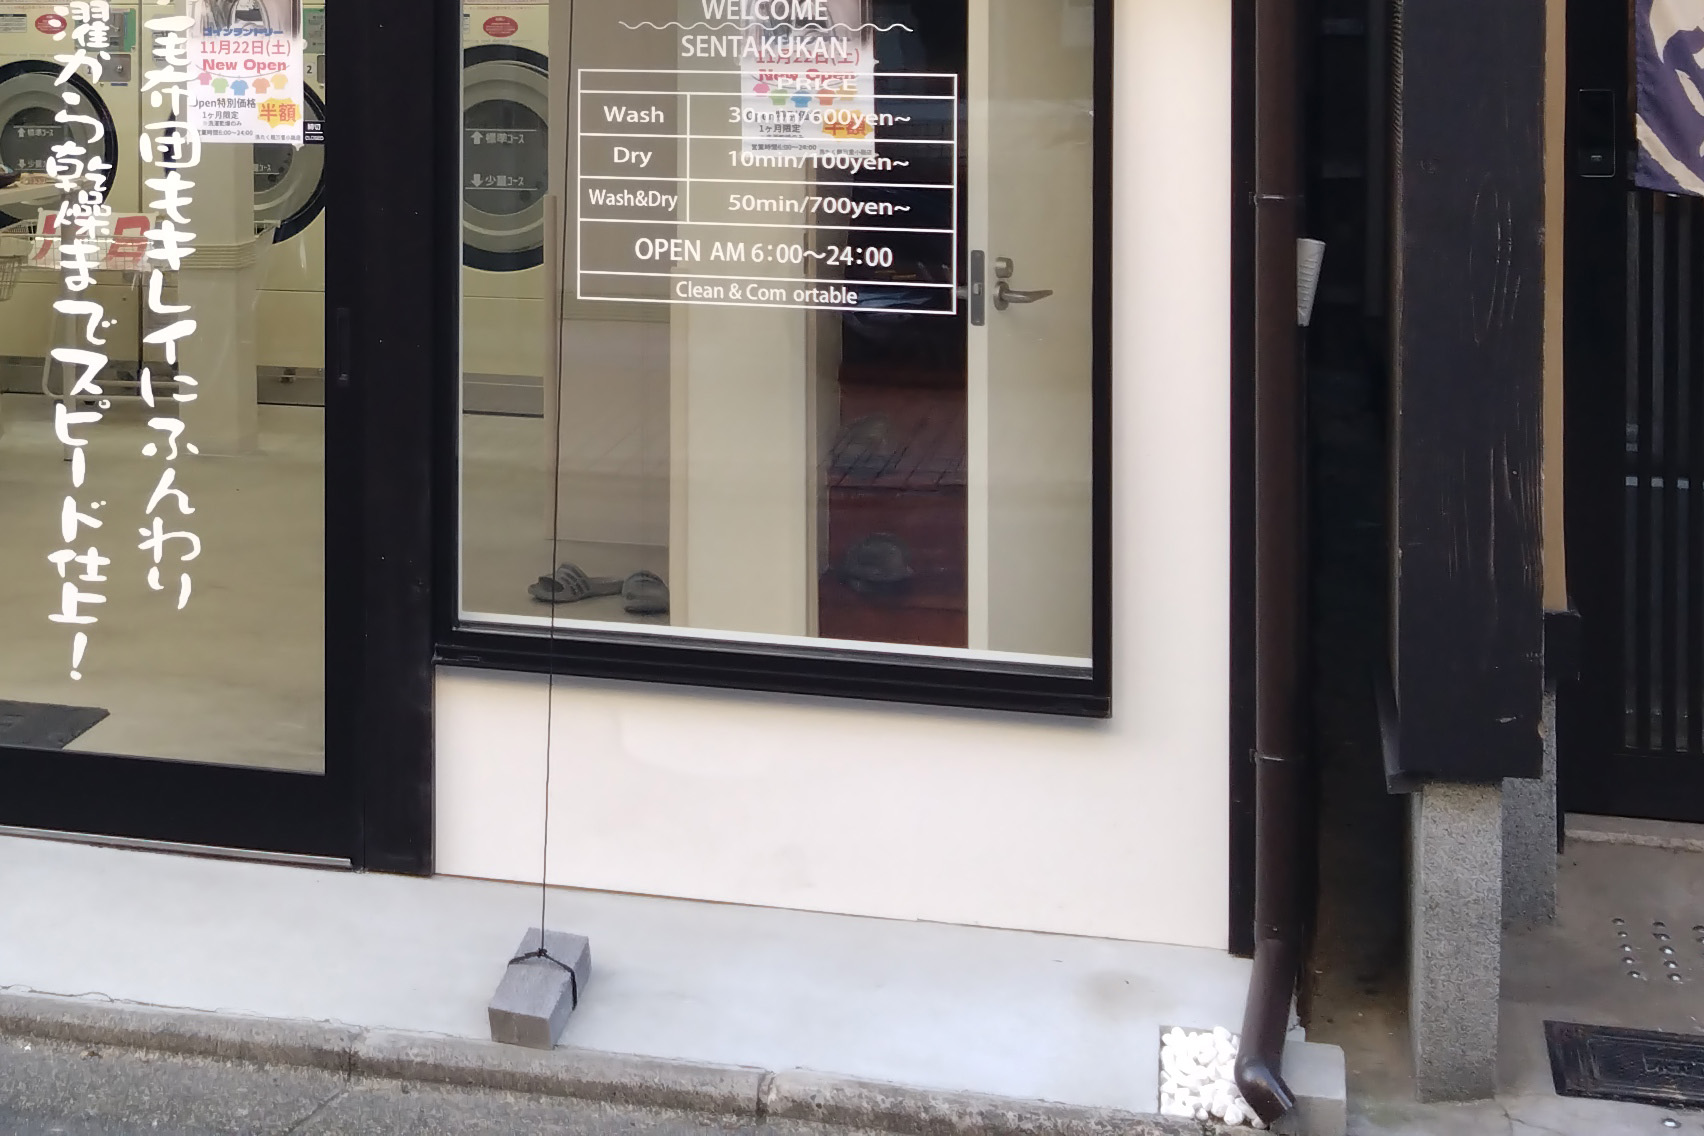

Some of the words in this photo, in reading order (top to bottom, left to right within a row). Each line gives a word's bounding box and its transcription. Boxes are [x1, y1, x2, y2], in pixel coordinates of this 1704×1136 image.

[200, 40, 291, 57] 11月22日(土)
[681, 35, 848, 59] SENTAKUKAN
[202, 58, 237, 71] New
[243, 58, 287, 74] Open
[777, 76, 858, 92] PRICE
[259, 103, 297, 123] 半額
[603, 105, 665, 124] Wash
[613, 147, 653, 170] Dry
[588, 188, 679, 213] Wash&Dry
[635, 237, 701, 262] OPEN
[711, 241, 745, 263] AM
[676, 280, 725, 300] Clean
[728, 282, 743, 301] &
